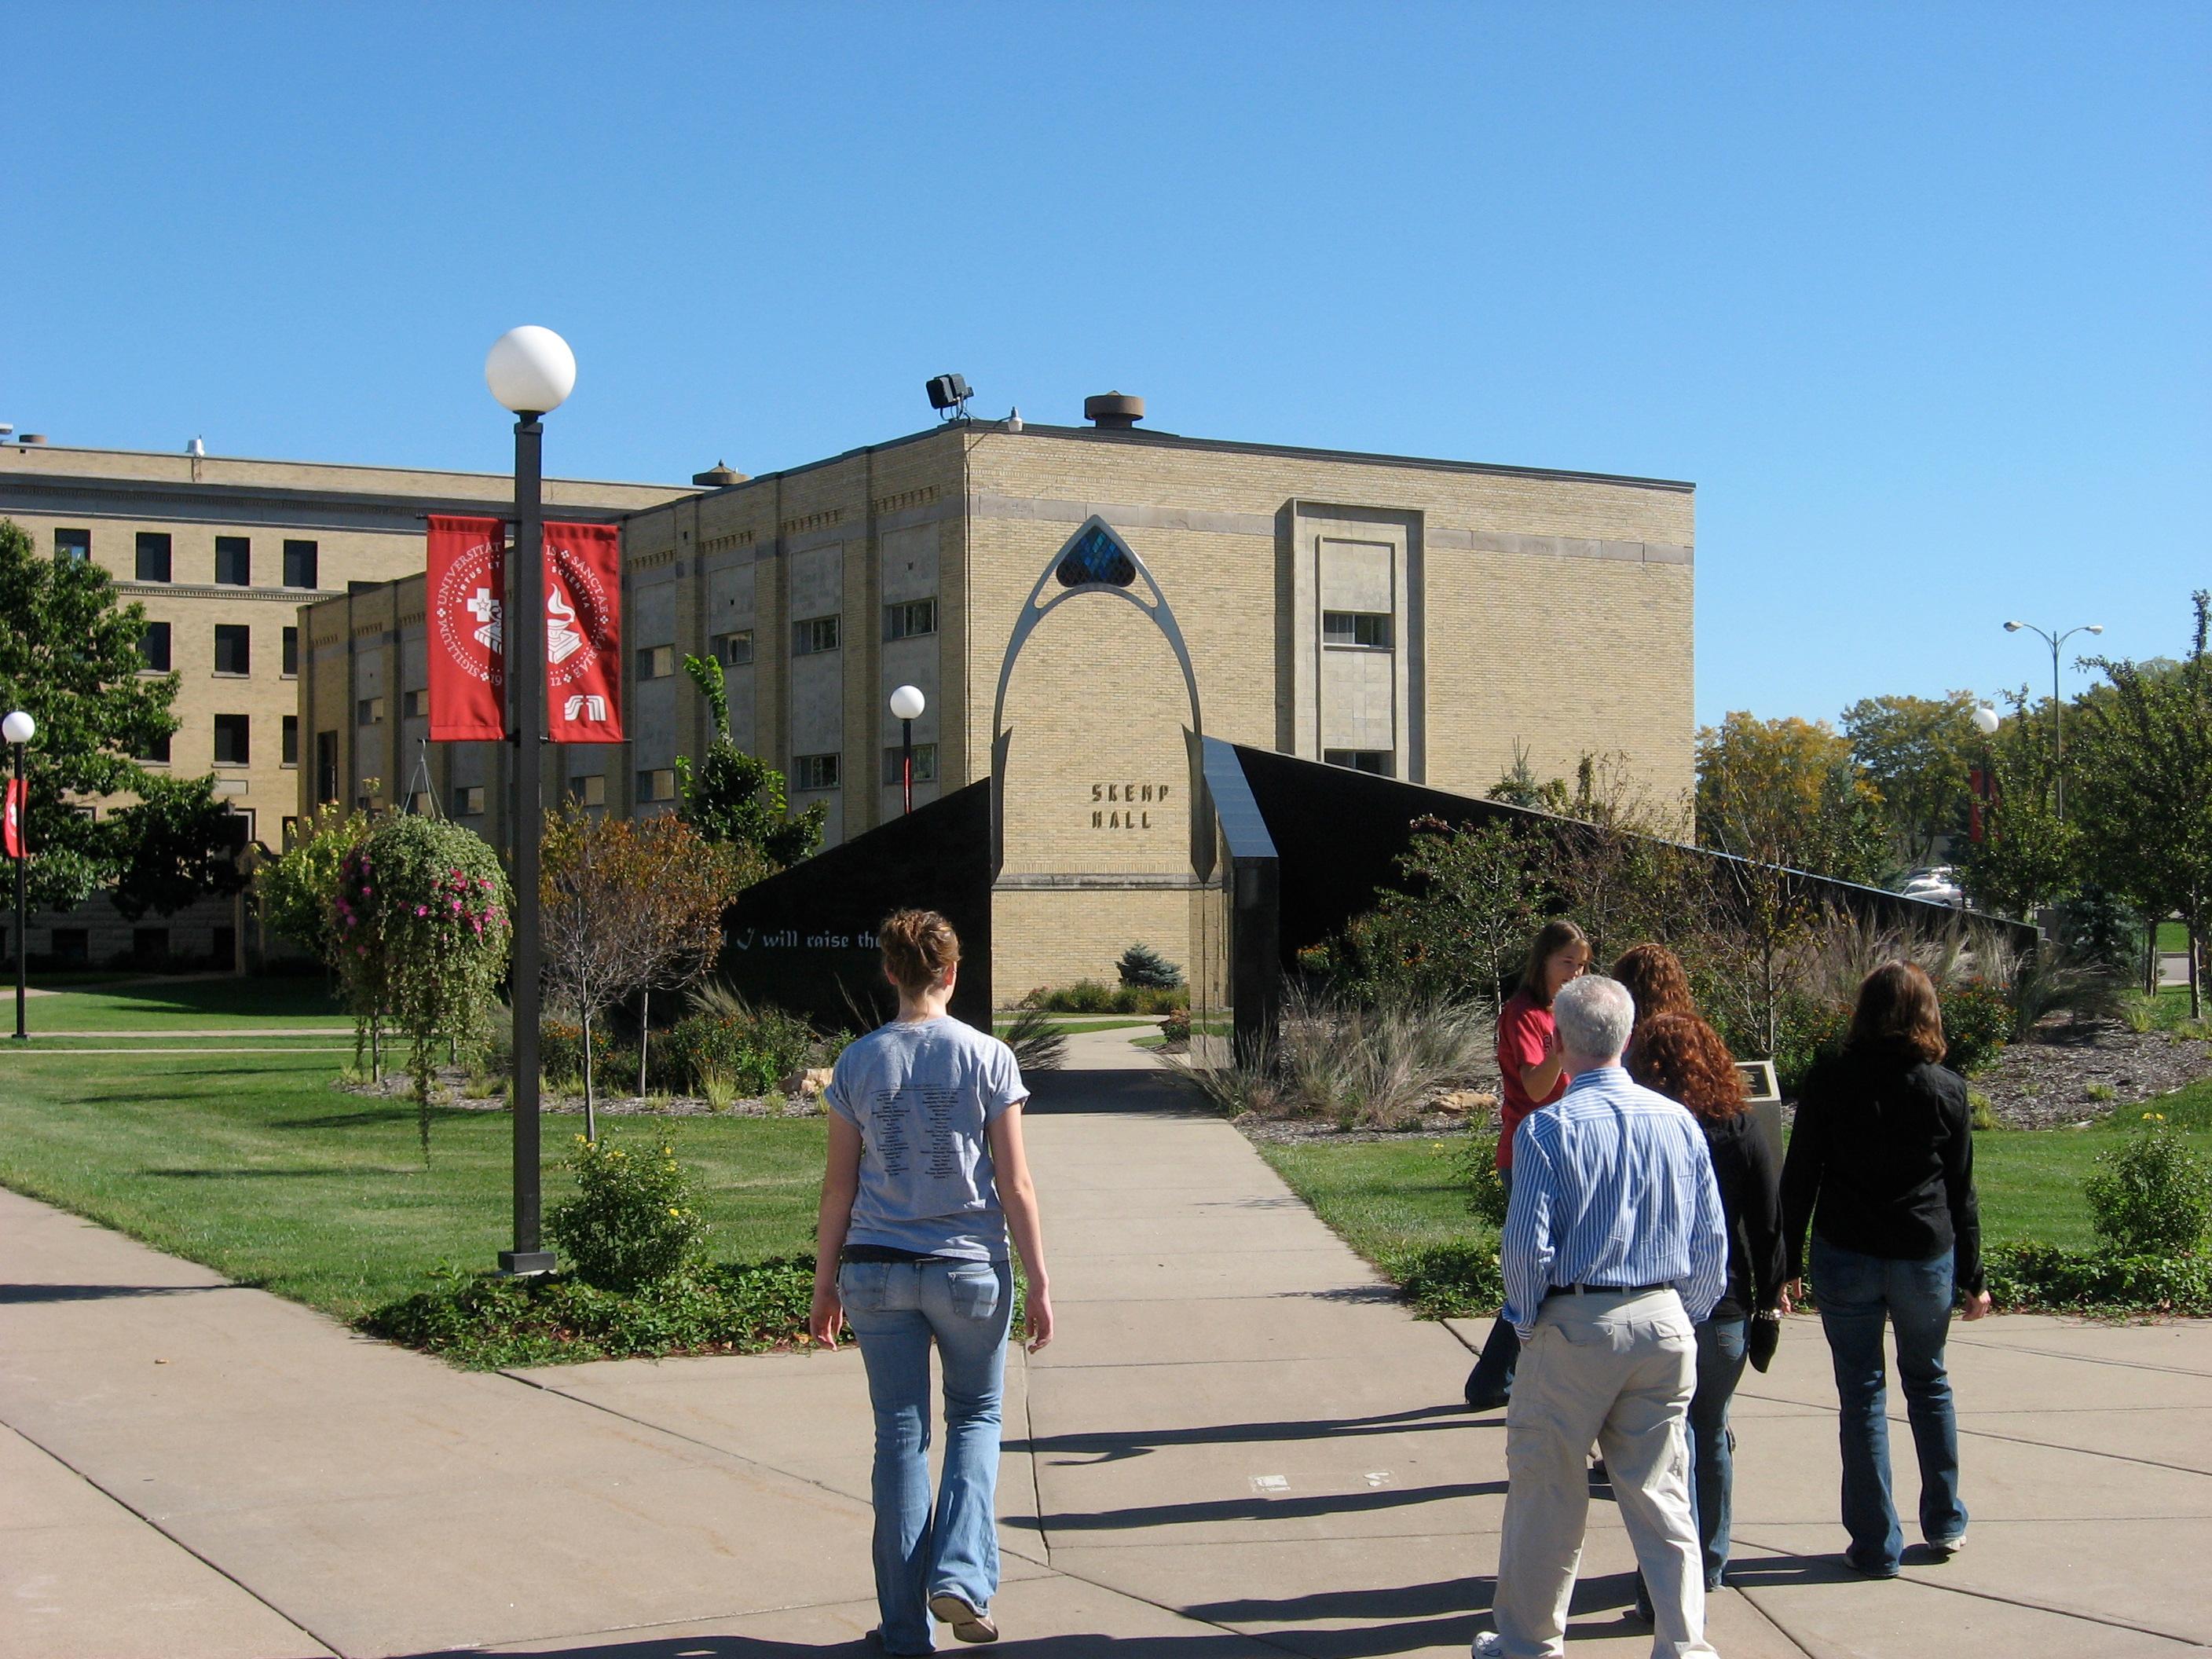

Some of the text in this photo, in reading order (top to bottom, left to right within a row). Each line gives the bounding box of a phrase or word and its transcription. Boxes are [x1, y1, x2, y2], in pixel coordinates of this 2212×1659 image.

[456, 561, 500, 602] VIRTUS ET
[551, 566, 590, 608] SCIENTIA
[438, 541, 501, 678] SIGILLUM UNIVERSITAT
[1092, 784, 1169, 802] SKEMP
[1092, 811, 1152, 829] HALL
[763, 930, 798, 947] will
[807, 930, 849, 947] raise
